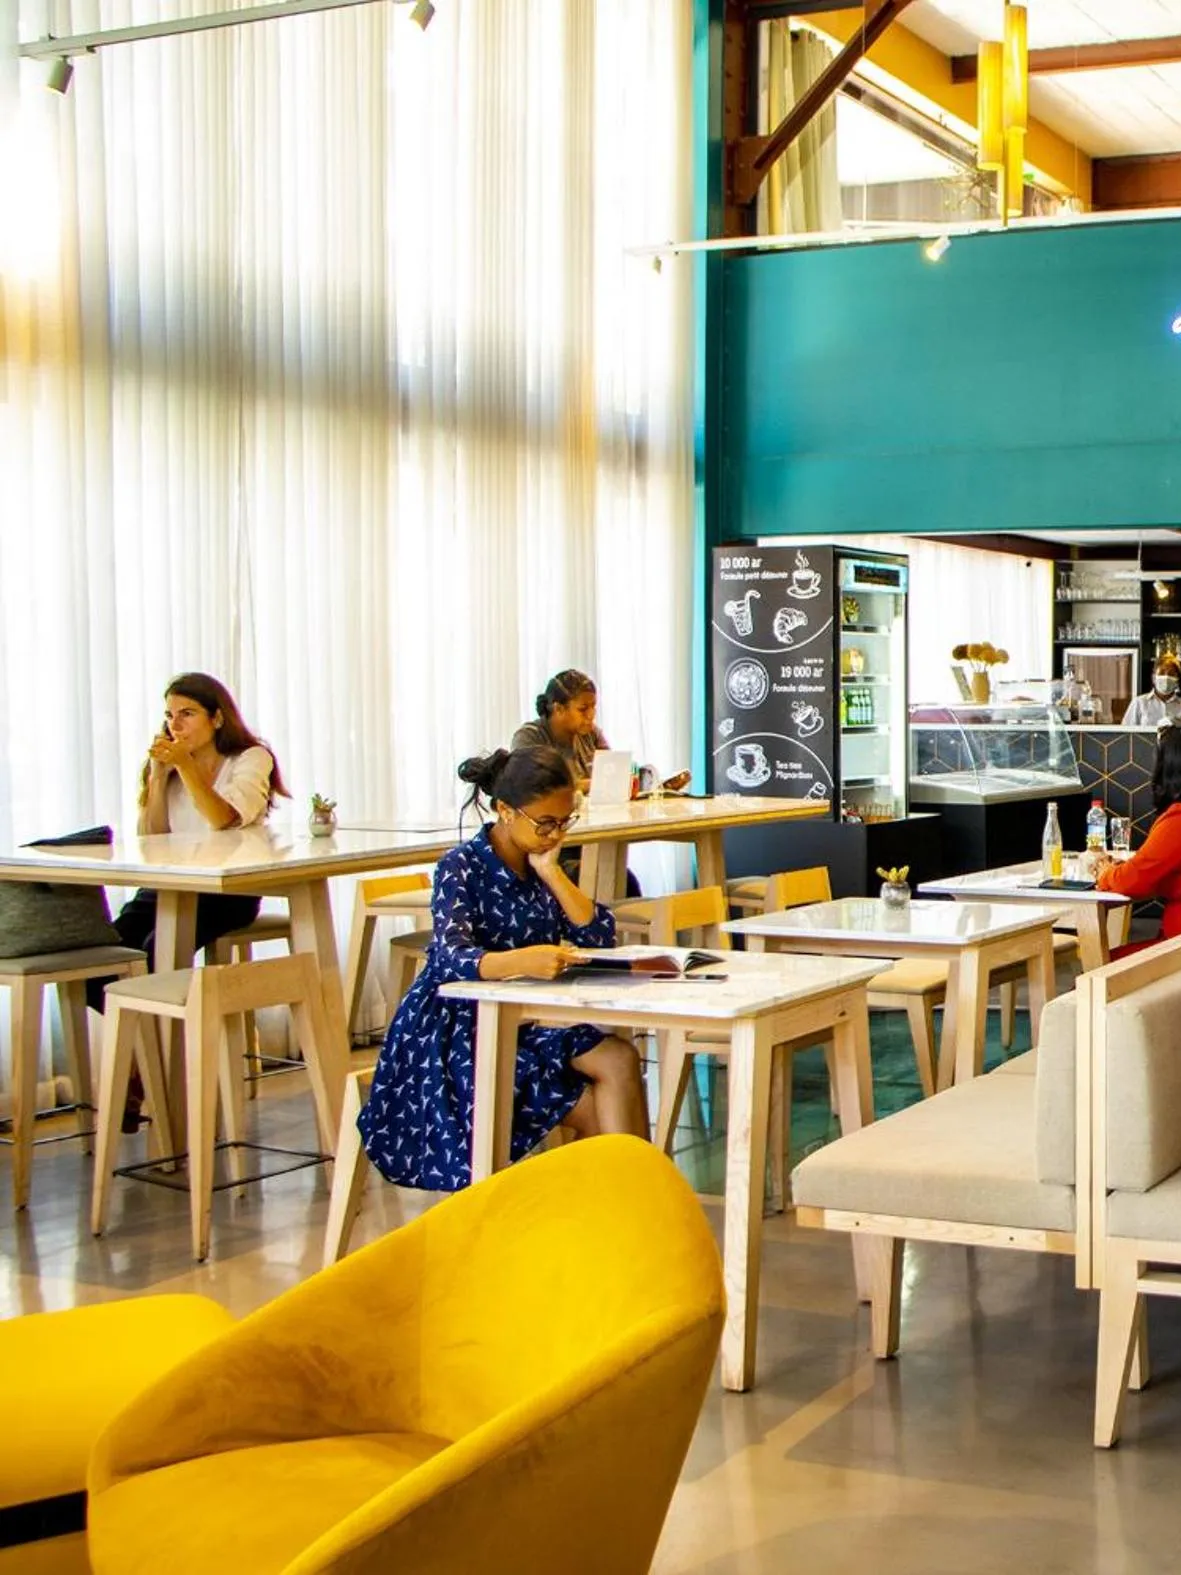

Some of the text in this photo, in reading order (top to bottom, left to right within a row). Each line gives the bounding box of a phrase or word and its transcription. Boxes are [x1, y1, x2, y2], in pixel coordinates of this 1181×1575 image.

[719, 557, 731, 569] 10
[732, 556, 750, 569] 000
[781, 666, 792, 678] 19
[793, 666, 811, 678] 000
